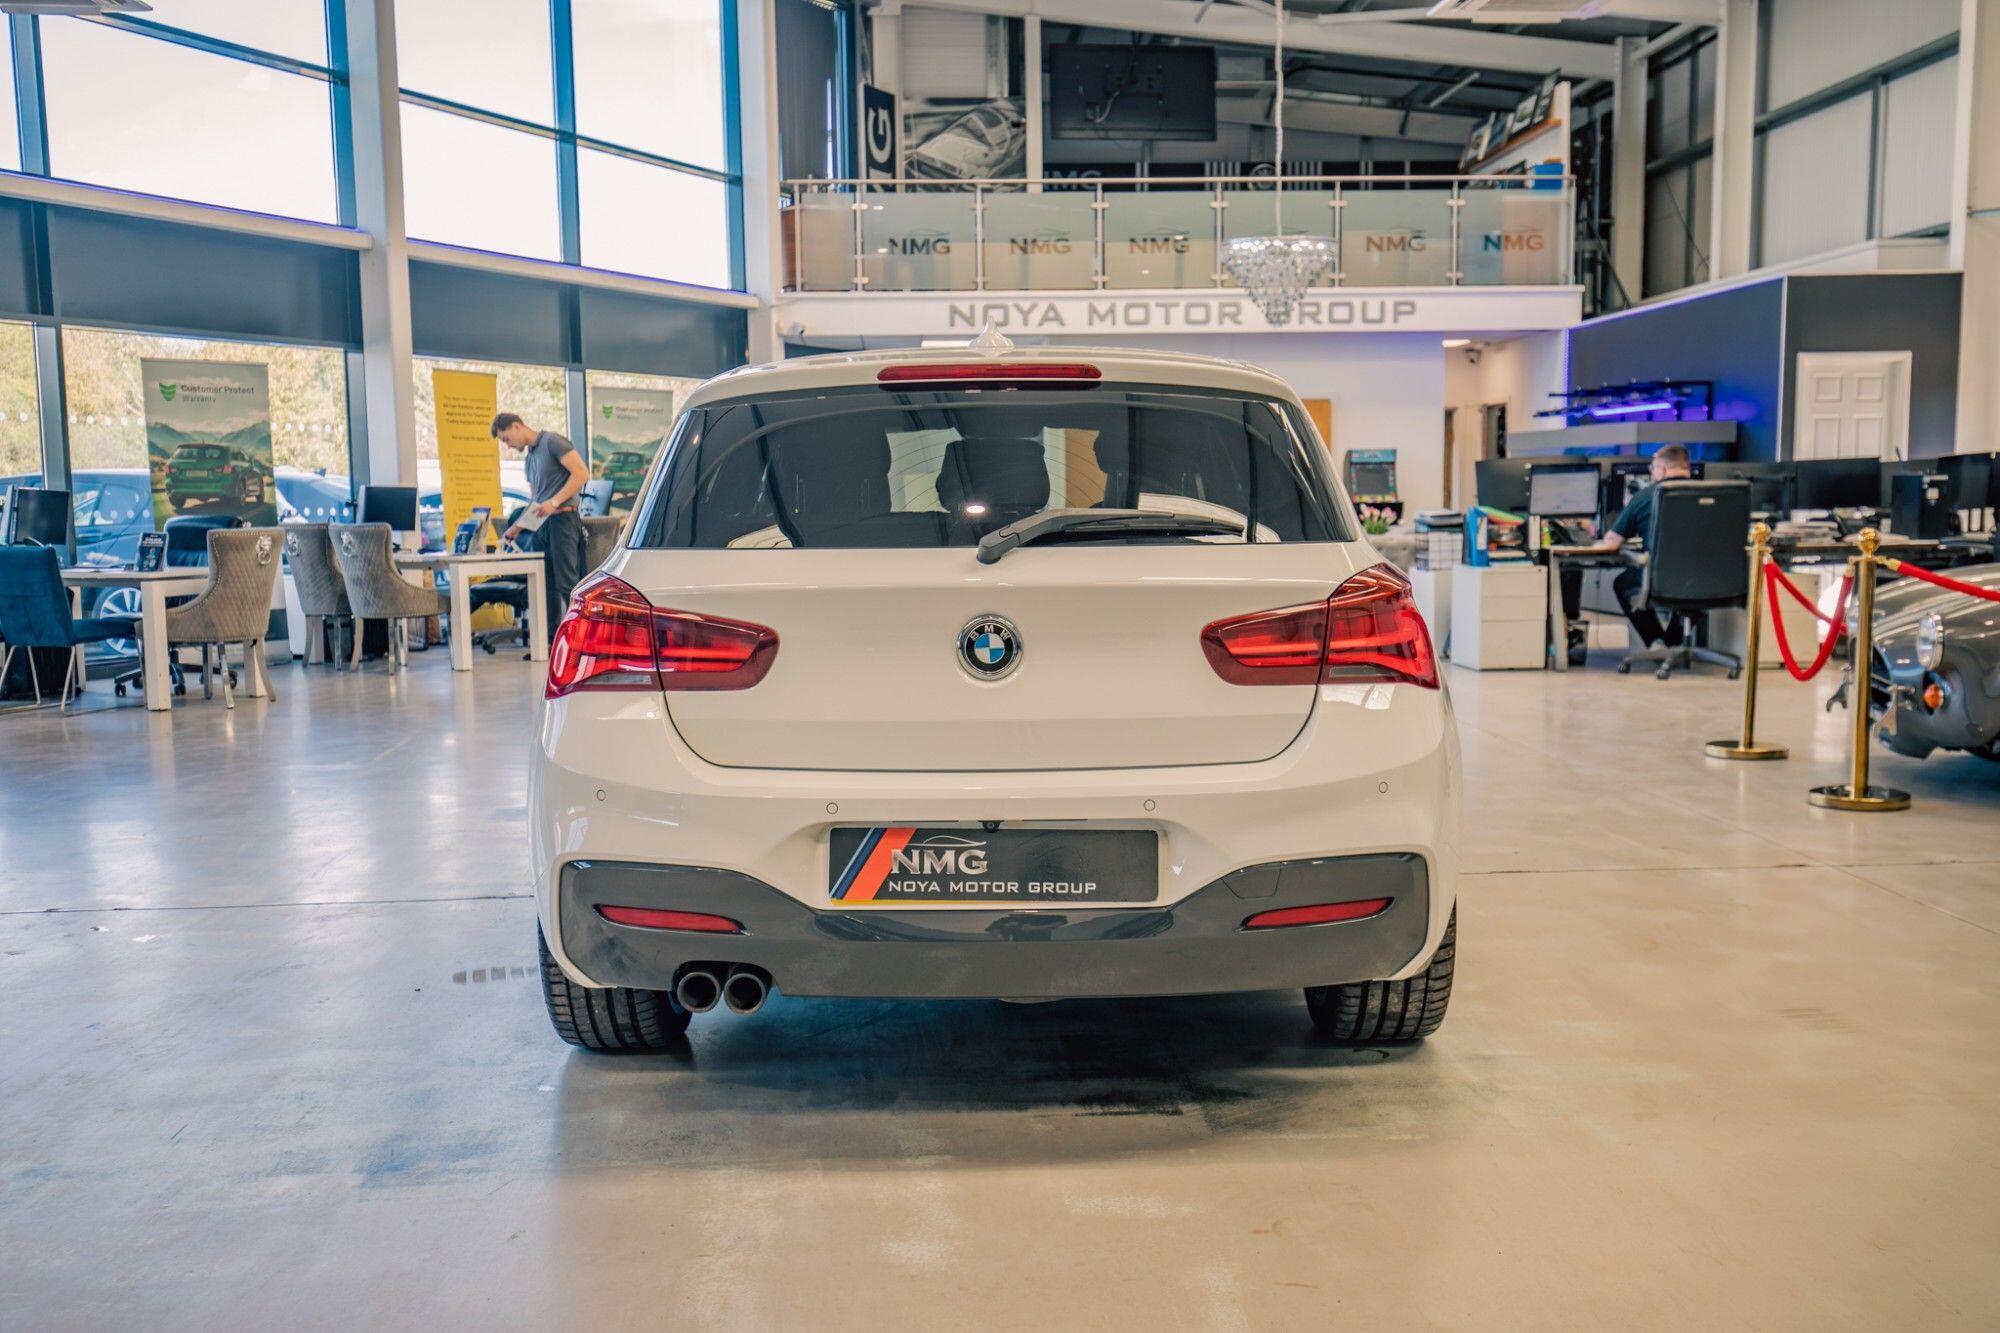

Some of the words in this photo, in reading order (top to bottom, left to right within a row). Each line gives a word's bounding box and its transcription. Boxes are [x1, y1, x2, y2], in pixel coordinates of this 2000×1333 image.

[889, 238, 950, 255] NMG
[1009, 237, 1071, 254] NMG
[1129, 237, 1190, 254] NMG
[1366, 235, 1426, 252] NMG
[1483, 234, 1544, 251] NMG
[949, 303, 1065, 327] NOYA
[1088, 301, 1242, 325] MOTOR
[181, 384, 222, 393] Customer
[970, 624, 1010, 640] BMW
[891, 848, 988, 875] NMG
[889, 881, 940, 893] NOYA
[950, 881, 1019, 893] MOTOR
[1028, 881, 1097, 894] GROUP
